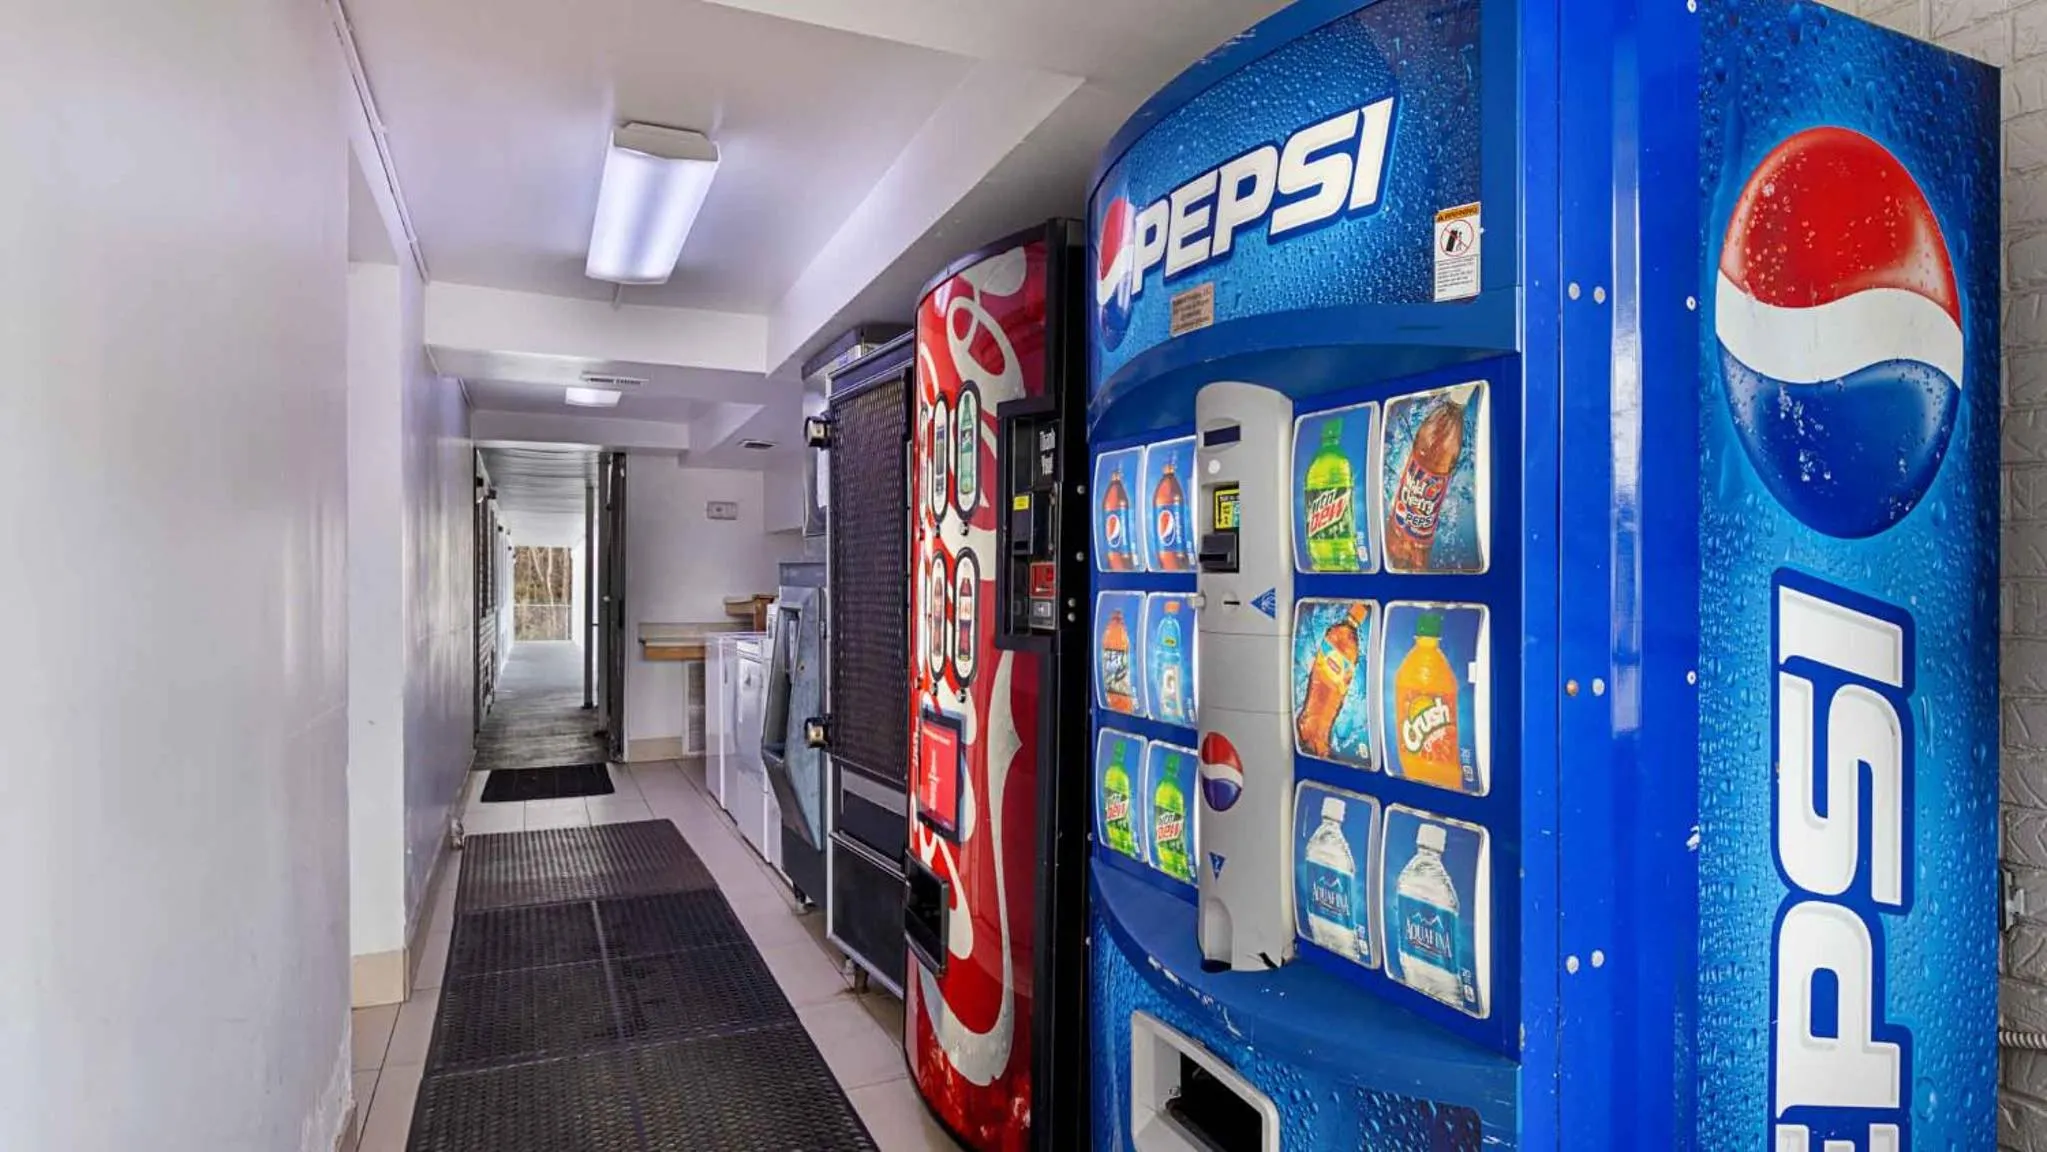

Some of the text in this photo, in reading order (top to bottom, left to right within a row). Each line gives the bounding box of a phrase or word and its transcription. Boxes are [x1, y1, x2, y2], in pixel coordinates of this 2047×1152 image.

[1131, 96, 1395, 295] PEPSI
[1403, 697, 1450, 752] Crush
[1406, 917, 1453, 959] AQUAFINA
